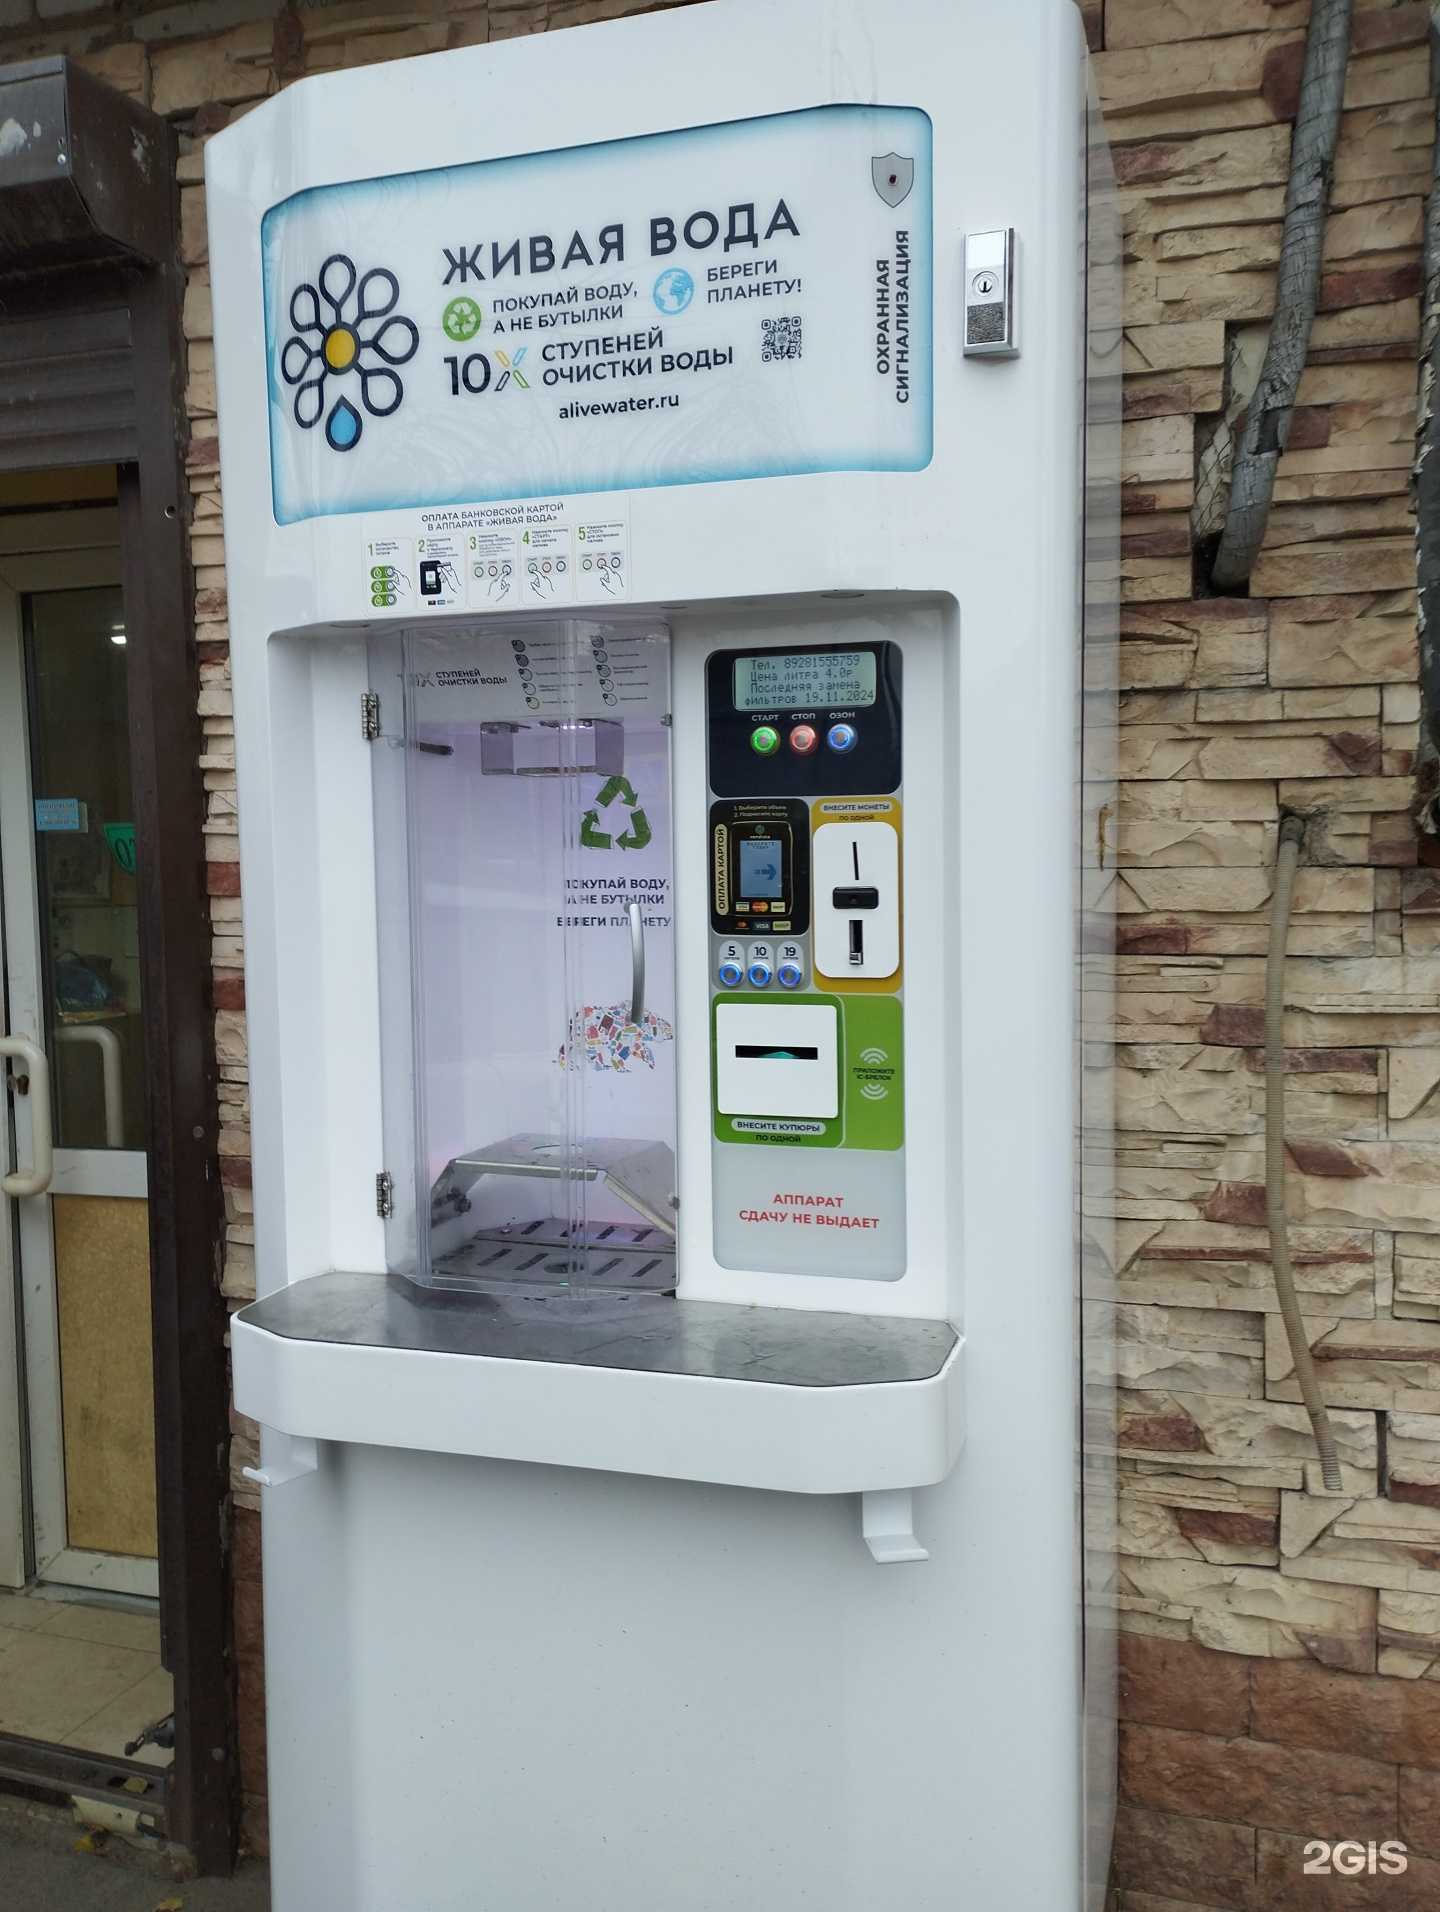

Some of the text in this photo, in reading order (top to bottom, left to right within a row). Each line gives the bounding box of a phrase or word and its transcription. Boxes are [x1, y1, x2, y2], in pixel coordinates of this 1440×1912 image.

[442, 198, 800, 285] ЖИВАЯ ВОДА
[707, 260, 778, 282] БЕРЕГИ
[493, 281, 639, 314] ПОКУПАЙ ВОДУ,
[707, 279, 802, 304] ПЛАНЕТУ!
[493, 305, 624, 334] А НЕ БУТЫЛКИ
[876, 259, 890, 375] ОХРАННАЯ
[895, 230, 912, 404] СИГНАЛИЗАЦИЯ
[541, 326, 664, 361] СТУПЕНЕЙ
[542, 346, 733, 386] ОЧИСТКИ ВОДЫ
[558, 394, 680, 419] alivewater.ru
[421, 502, 564, 522] ОПЛАТА БАНКОВСКОЙ КАРТОЙ
[427, 522, 434, 531] В
[436, 519, 483, 531] АППАРАТЕ
[522, 531, 530, 544] 4
[578, 526, 586, 541] 5
[367, 543, 374, 556] 1
[418, 540, 425, 553] 2
[470, 536, 477, 550] 3
[751, 660, 776, 670] Тел.
[435, 668, 481, 679] СТУПЕНЕЙ
[750, 671, 778, 682] Цена
[784, 671, 819, 681] литра
[438, 678, 479, 687] ОЧИСТКИ
[751, 681, 861, 694] Последняя замена
[751, 714, 780, 722] СТАРТ
[791, 712, 816, 721] СТОП
[829, 711, 856, 720] ОЗОН
[717, 828, 726, 910] ОПЛАТА КАРТОЙ
[630, 879, 670, 890] ВОДУ,
[601, 894, 664, 904] БУТЫЛКИ
[610, 917, 672, 927] ПЛНЕТУ
[727, 945, 736, 957] 5
[754, 946, 767, 957] 10
[784, 946, 797, 957] 19
[737, 1121, 820, 1132] ВНЕСИТЕ КУПЮРЫ
[770, 1134, 801, 1142] ОДНОЙ
[772, 1193, 844, 1208] АППАРАТ
[739, 1209, 880, 1229] СДАЧУ НЕ ВЫДАЕТ
